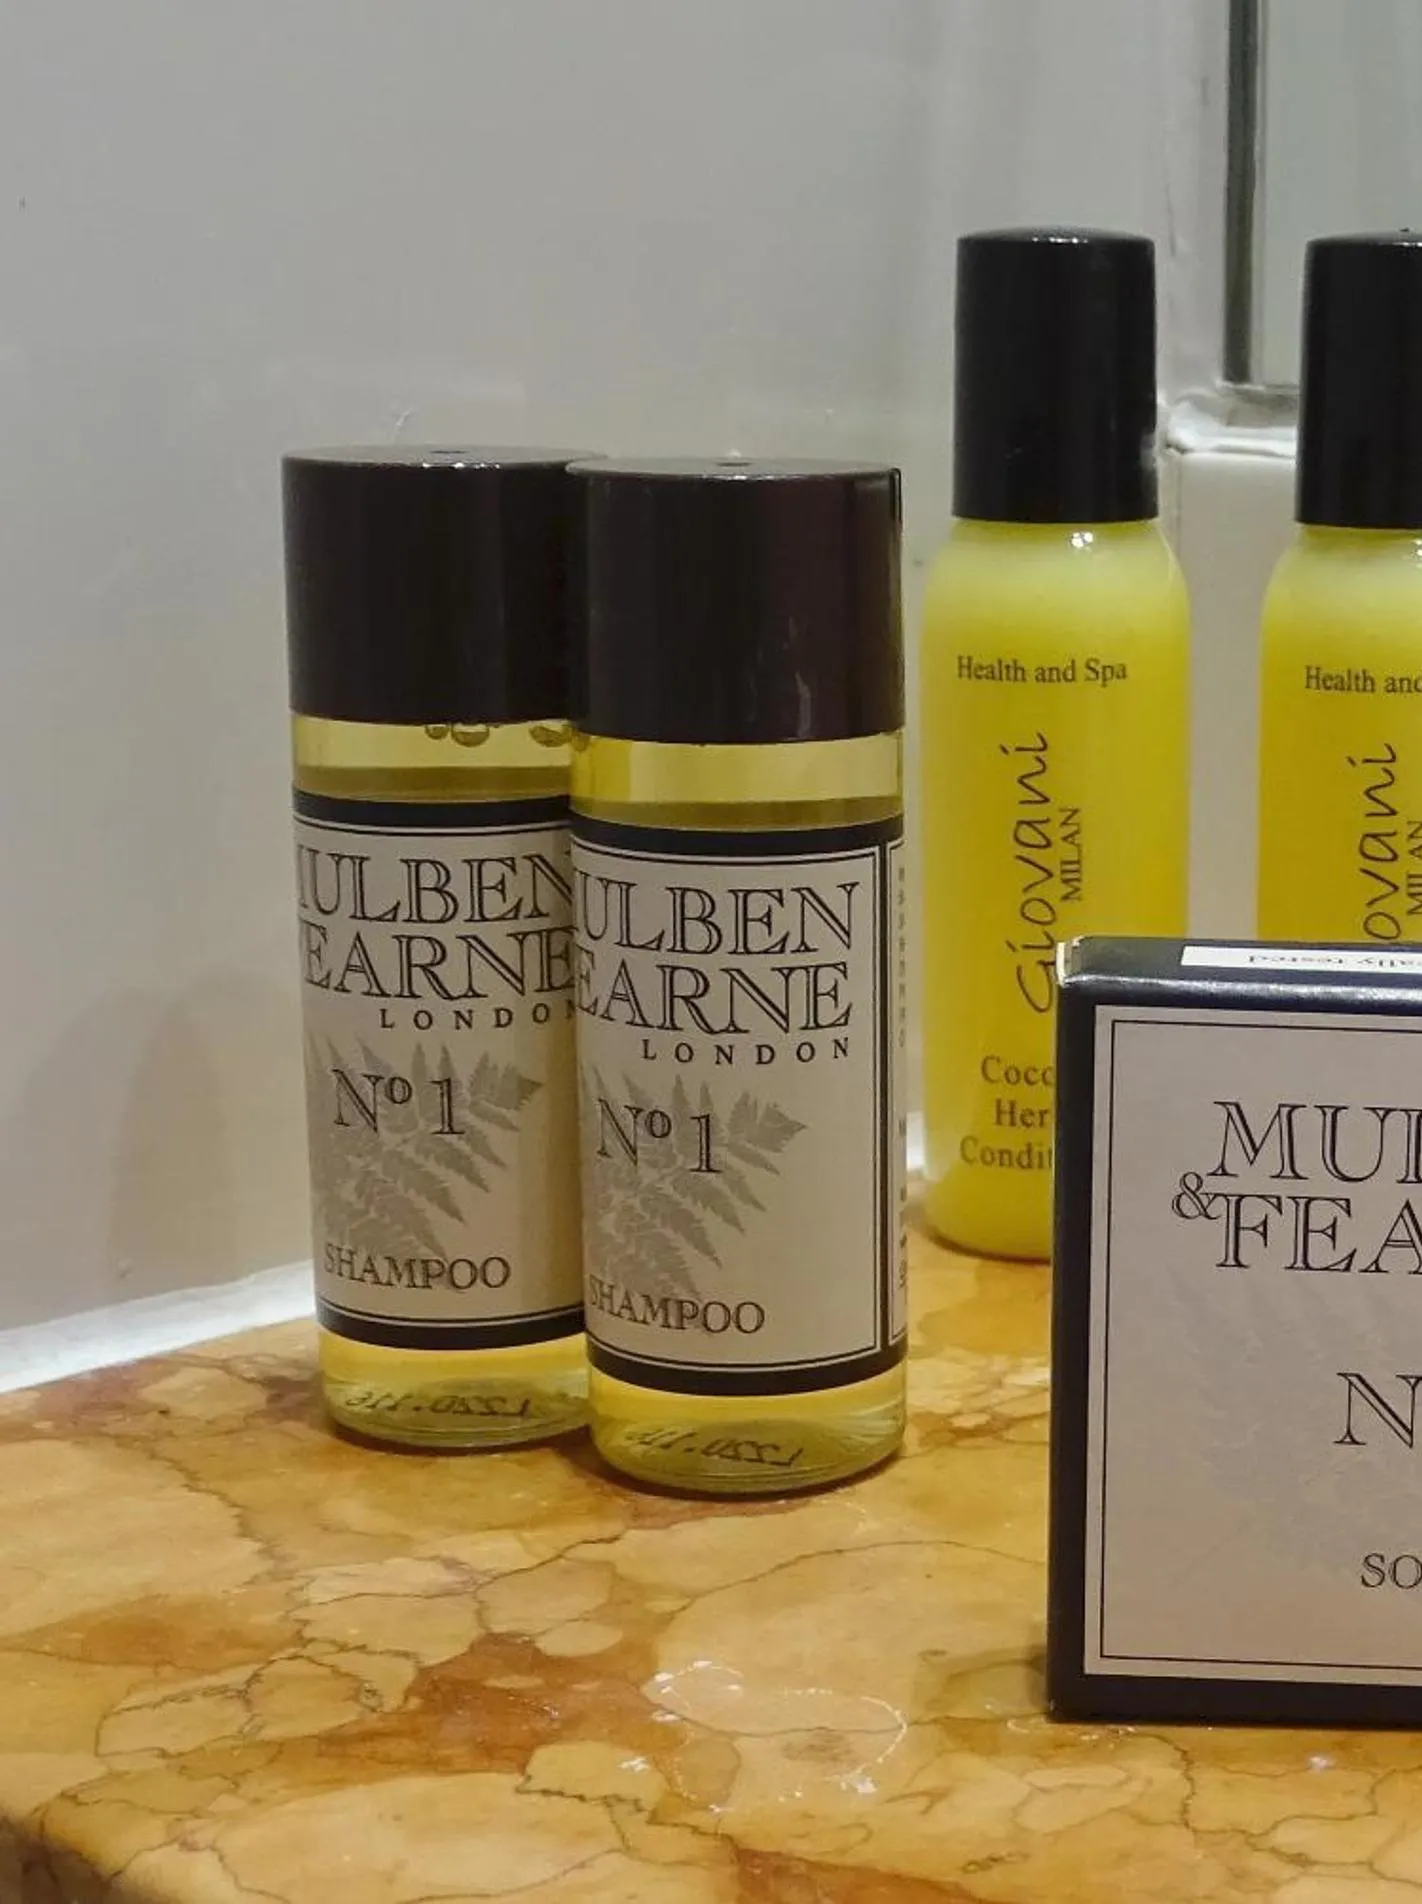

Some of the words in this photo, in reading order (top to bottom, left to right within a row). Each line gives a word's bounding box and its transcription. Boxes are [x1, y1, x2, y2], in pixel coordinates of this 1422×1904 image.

[957, 655, 1027, 683] Health
[1034, 658, 1077, 684] and
[1084, 656, 1128, 688] Spa
[1304, 665, 1376, 693] Health
[999, 731, 1057, 1013] Giovani
[1059, 807, 1083, 902] MILAN
[298, 844, 574, 924] ULBEN
[641, 1036, 850, 1065] LONDON
[324, 1243, 511, 1290] SHAMPOO
[588, 1273, 766, 1334] SHAMPOO
